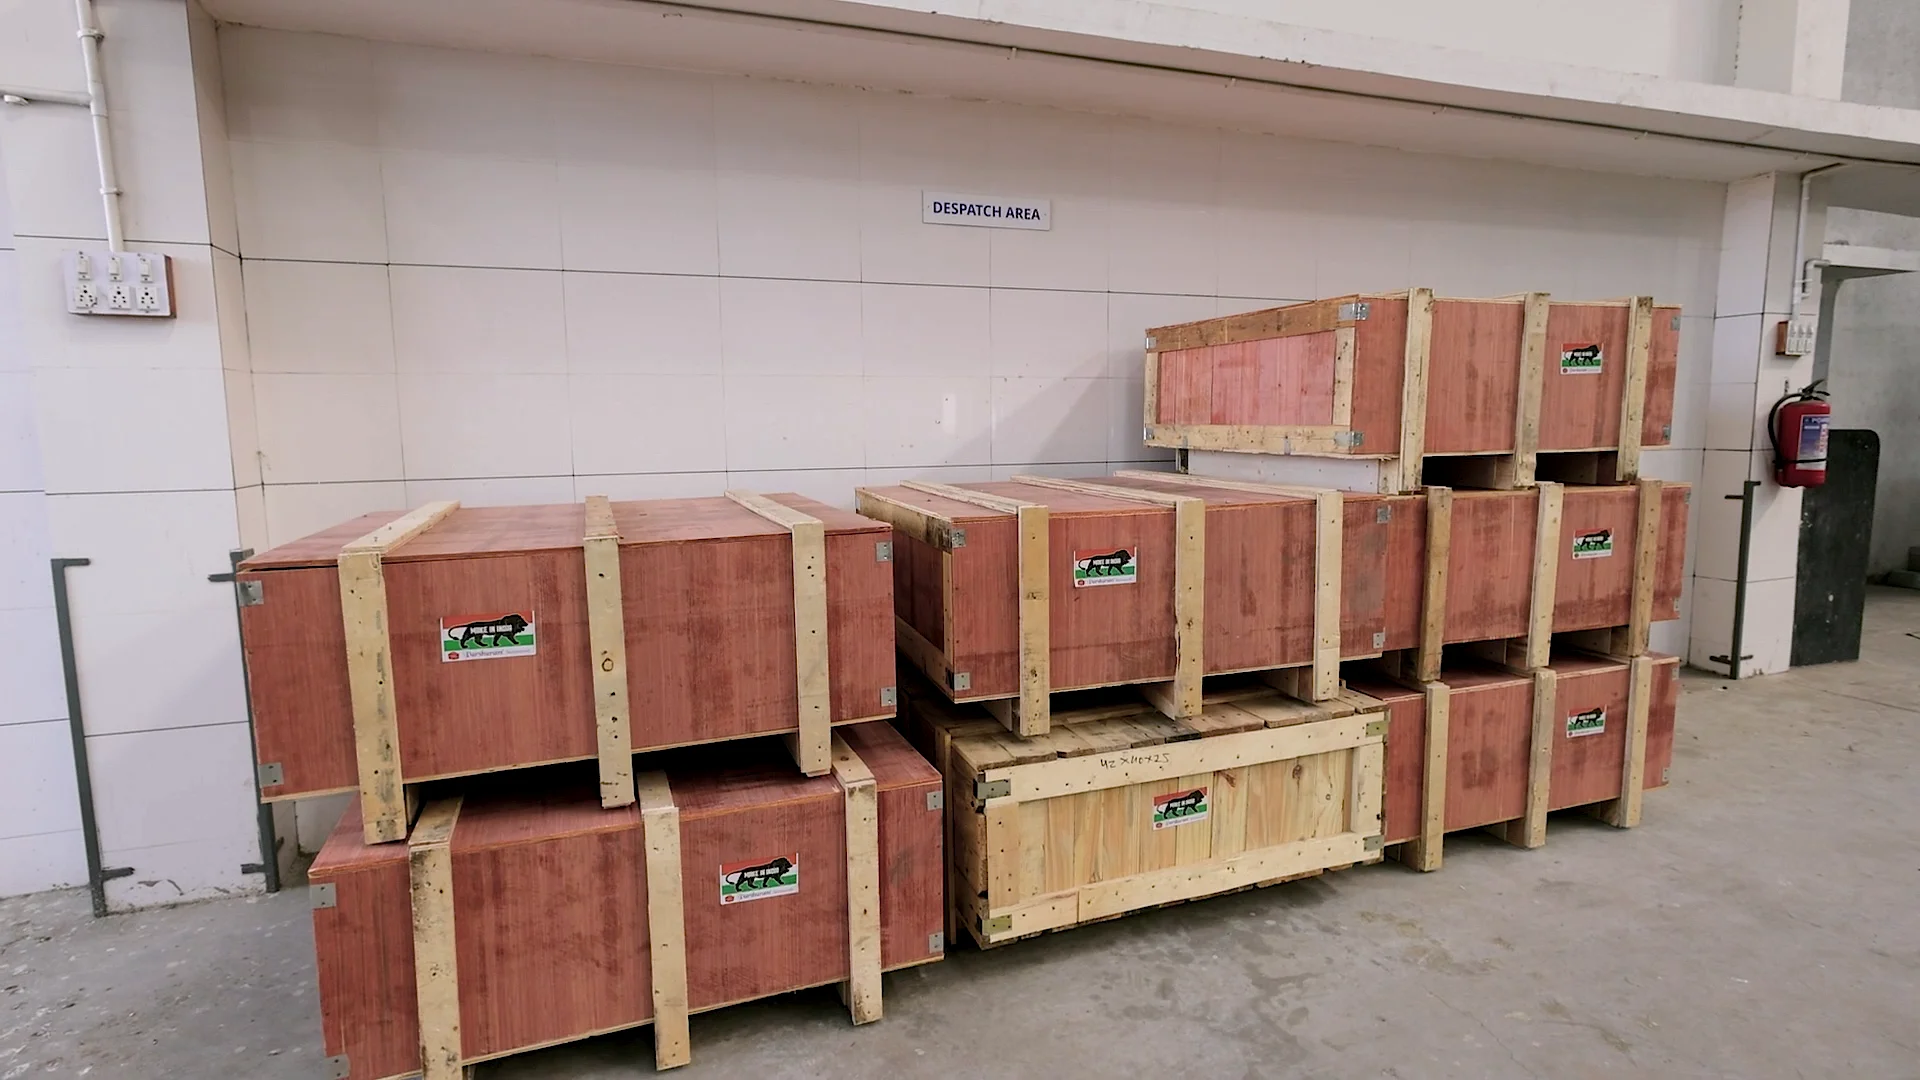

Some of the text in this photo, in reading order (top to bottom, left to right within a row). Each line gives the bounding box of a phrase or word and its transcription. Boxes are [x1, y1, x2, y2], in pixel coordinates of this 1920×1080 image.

[933, 201, 1041, 221] DESPATCH AREA
[470, 625, 488, 634] MAKE
[489, 625, 496, 633] IN
